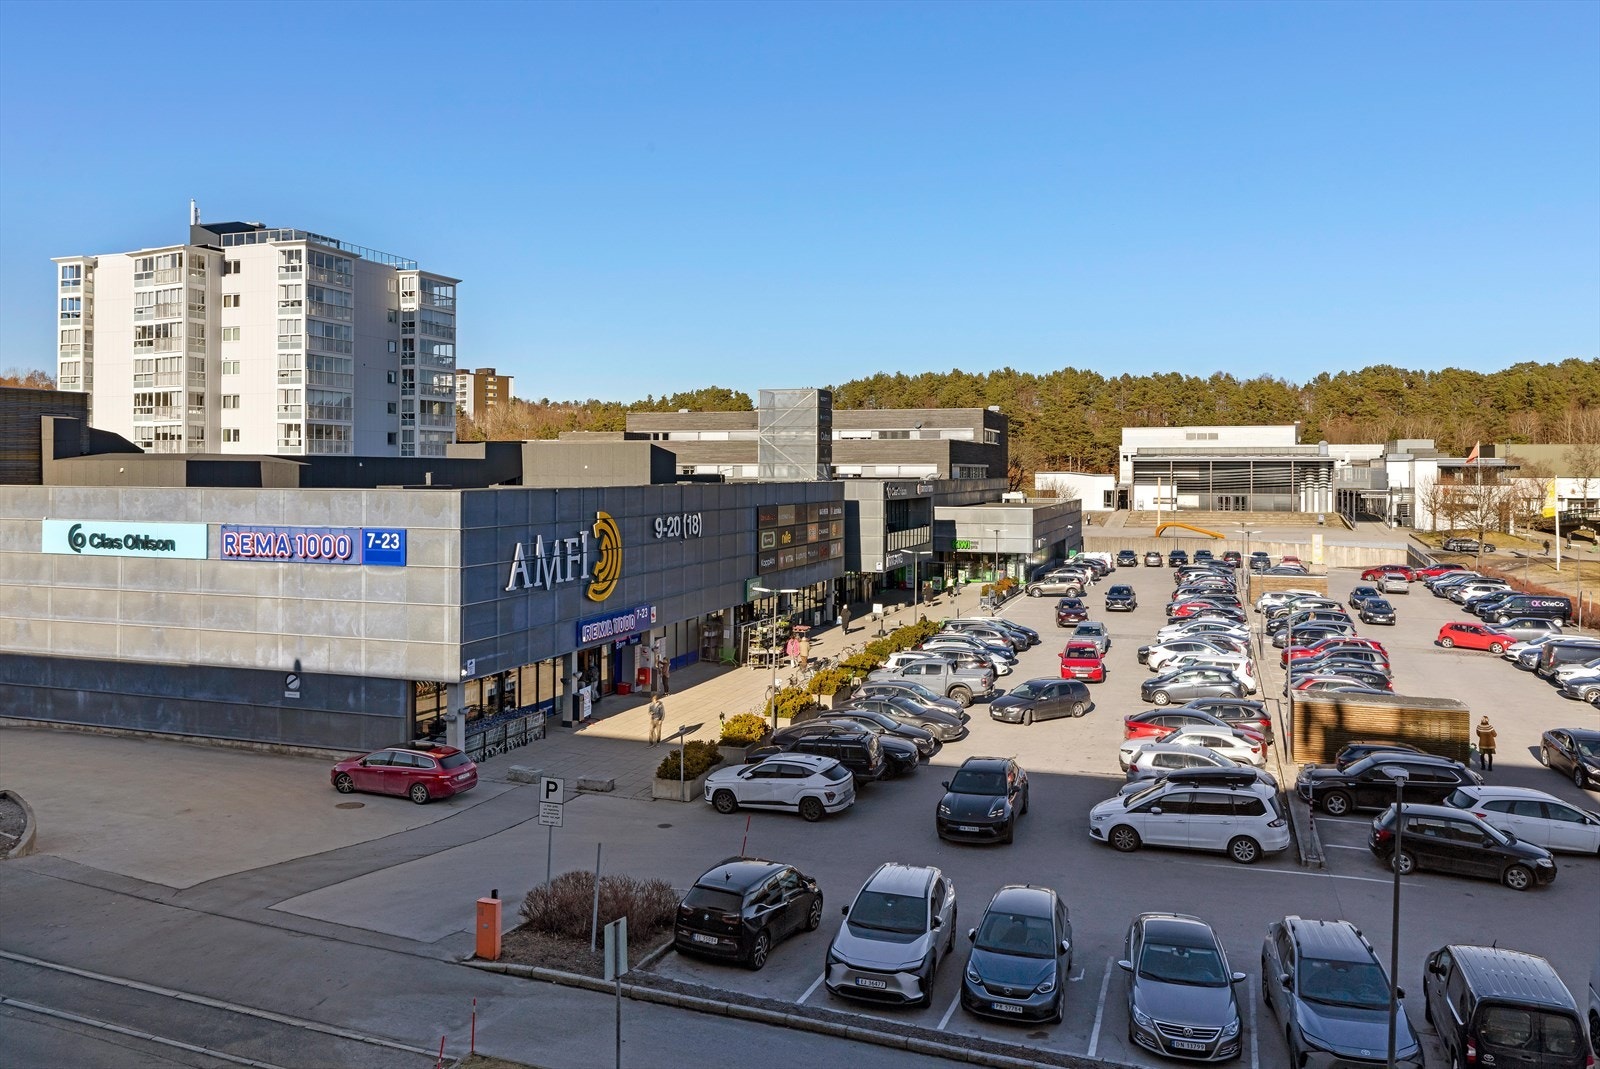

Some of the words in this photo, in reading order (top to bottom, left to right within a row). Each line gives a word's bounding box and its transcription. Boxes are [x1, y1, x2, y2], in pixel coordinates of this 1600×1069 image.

[655, 517, 681, 539] 9-20
[683, 512, 702, 539] (18)
[89, 533, 122, 549] Clas
[123, 534, 176, 552] Ohlson
[223, 532, 292, 558] REMA
[296, 534, 352, 560] 1000
[366, 532, 400, 550] 7-23
[505, 530, 590, 592] AMFI
[636, 607, 648, 620] 7-23
[582, 620, 613, 643] REMA
[613, 614, 635, 634] 1000
[546, 781, 558, 799] P
